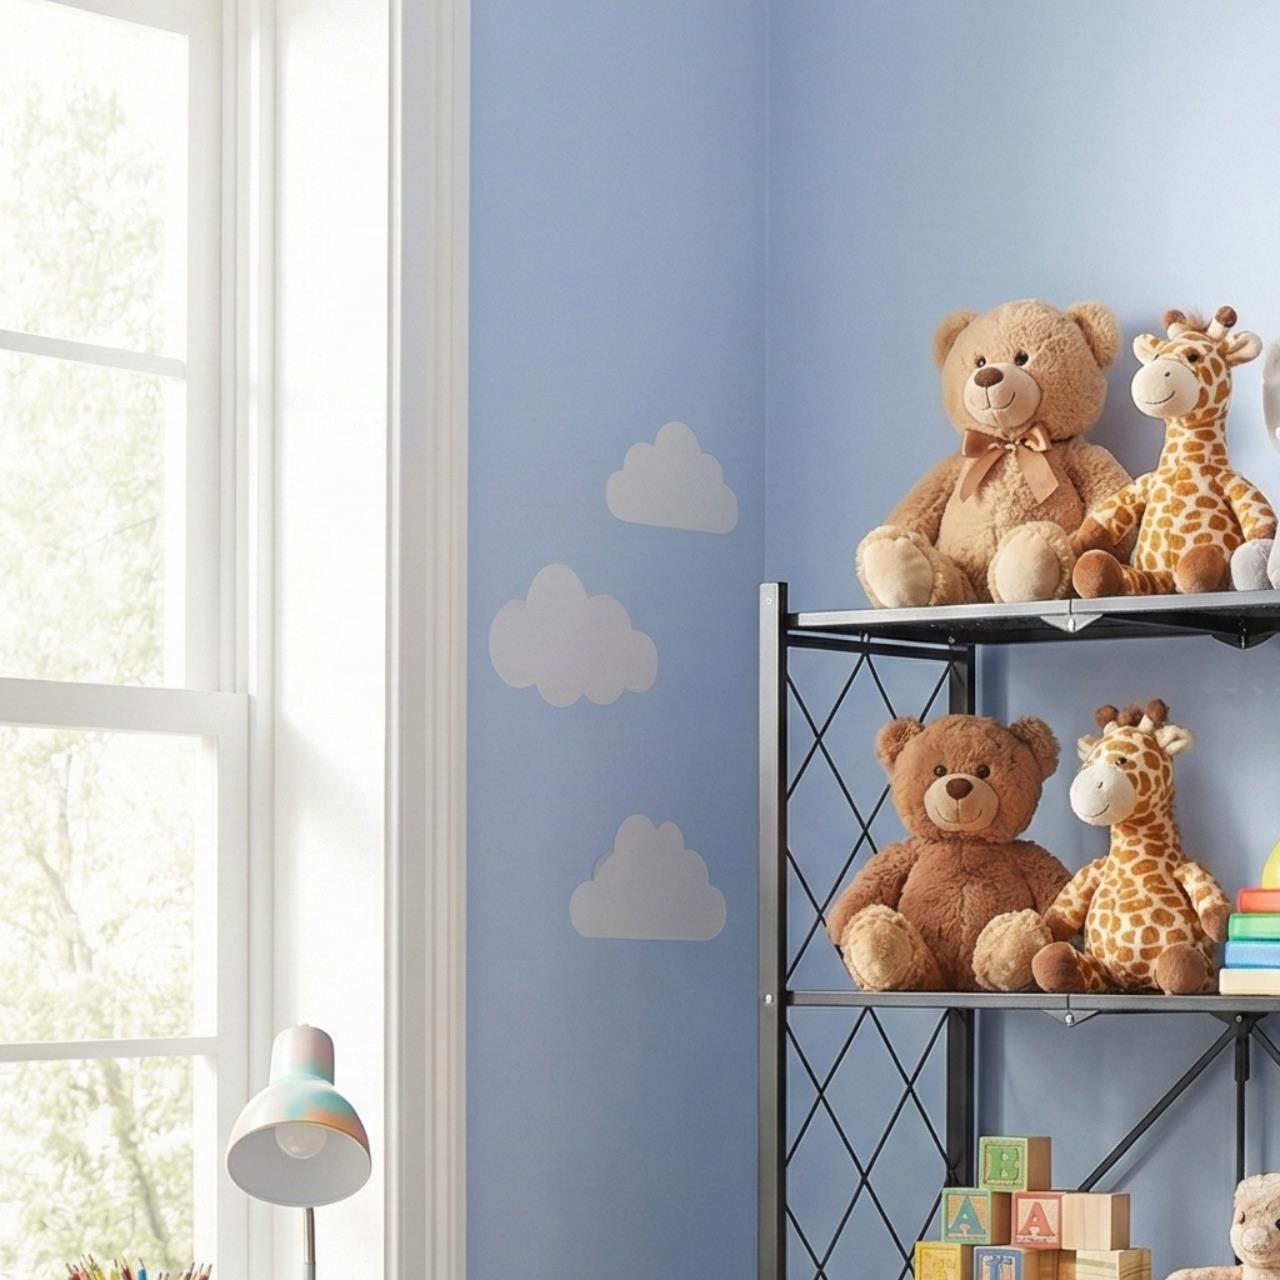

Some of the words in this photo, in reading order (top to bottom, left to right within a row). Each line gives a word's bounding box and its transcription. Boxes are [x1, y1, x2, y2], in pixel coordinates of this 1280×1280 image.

[987, 1145, 1020, 1182] B
[948, 1195, 987, 1234] A
[1016, 1200, 1056, 1238] A
